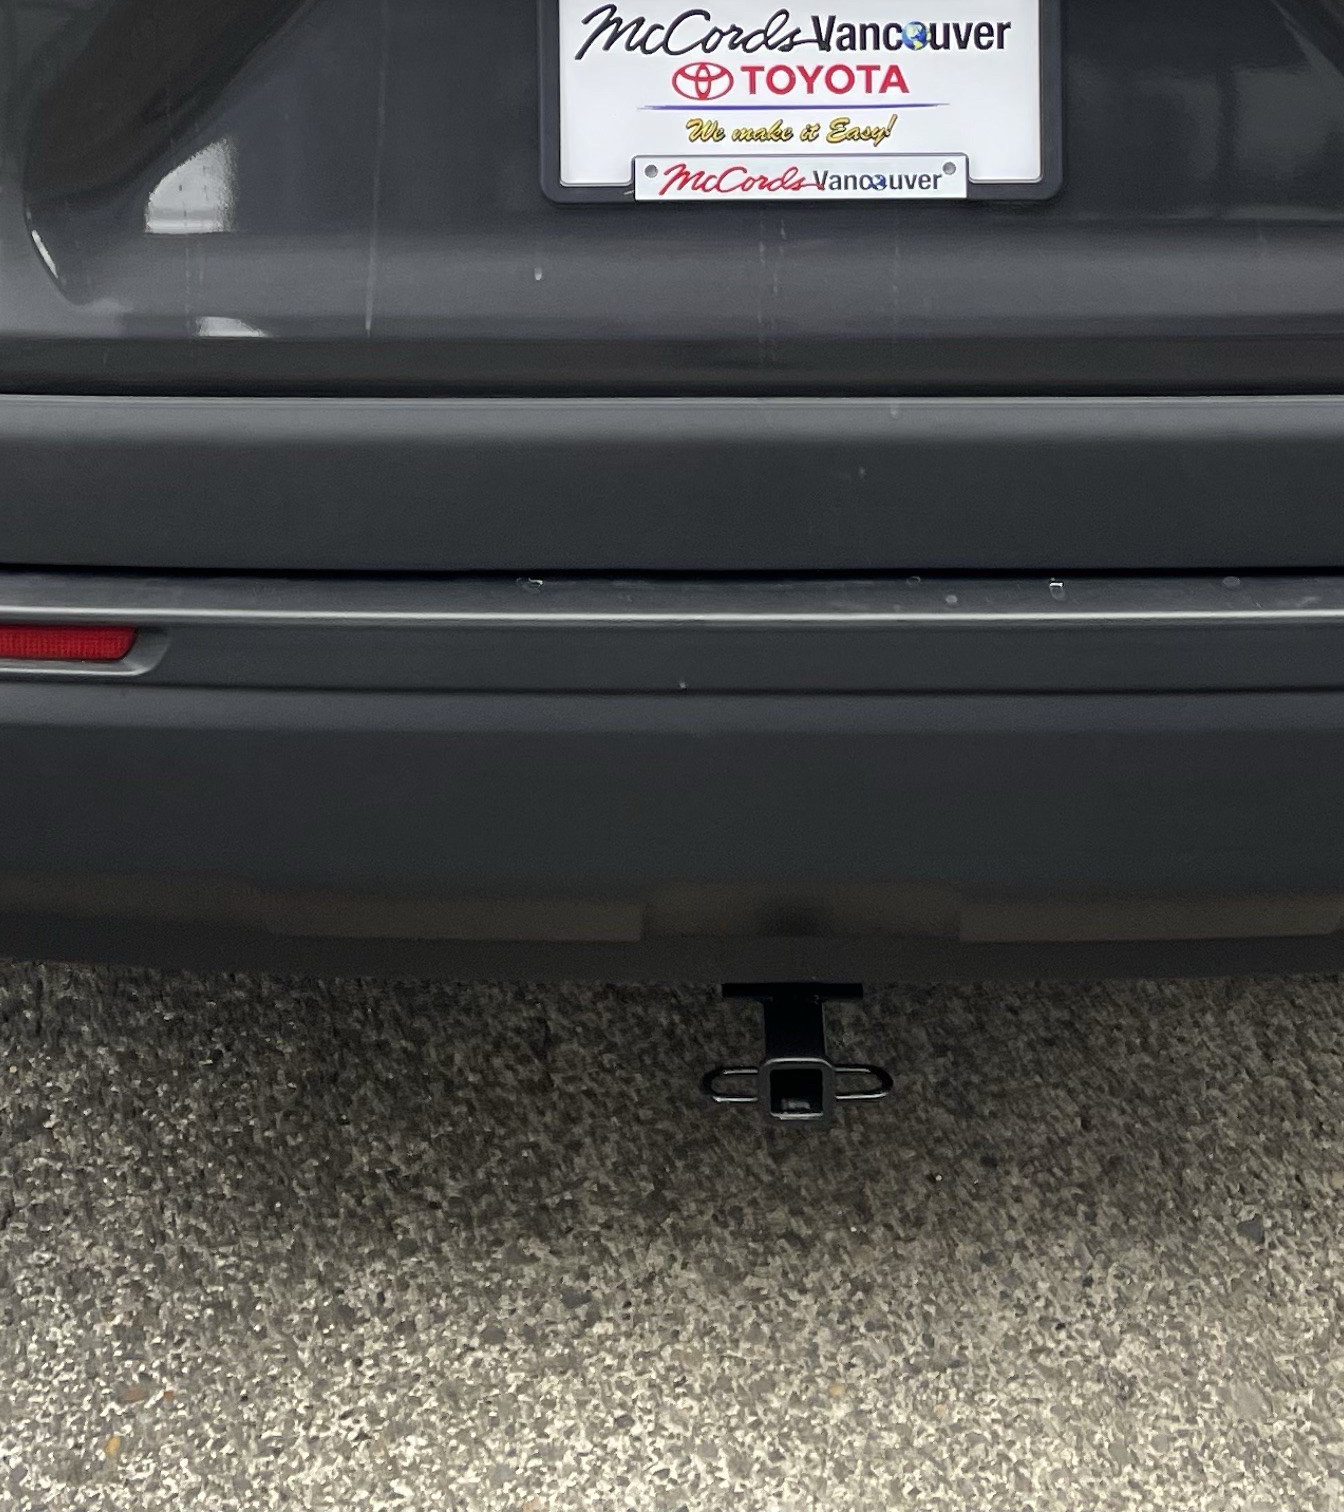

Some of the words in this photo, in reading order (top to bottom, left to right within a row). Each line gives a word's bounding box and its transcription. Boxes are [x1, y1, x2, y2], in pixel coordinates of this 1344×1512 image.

[740, 64, 910, 95] TOYOTA
[686, 117, 726, 142] We
[731, 119, 794, 142] make
[799, 123, 821, 142] it
[826, 113, 898, 147] Easy!
